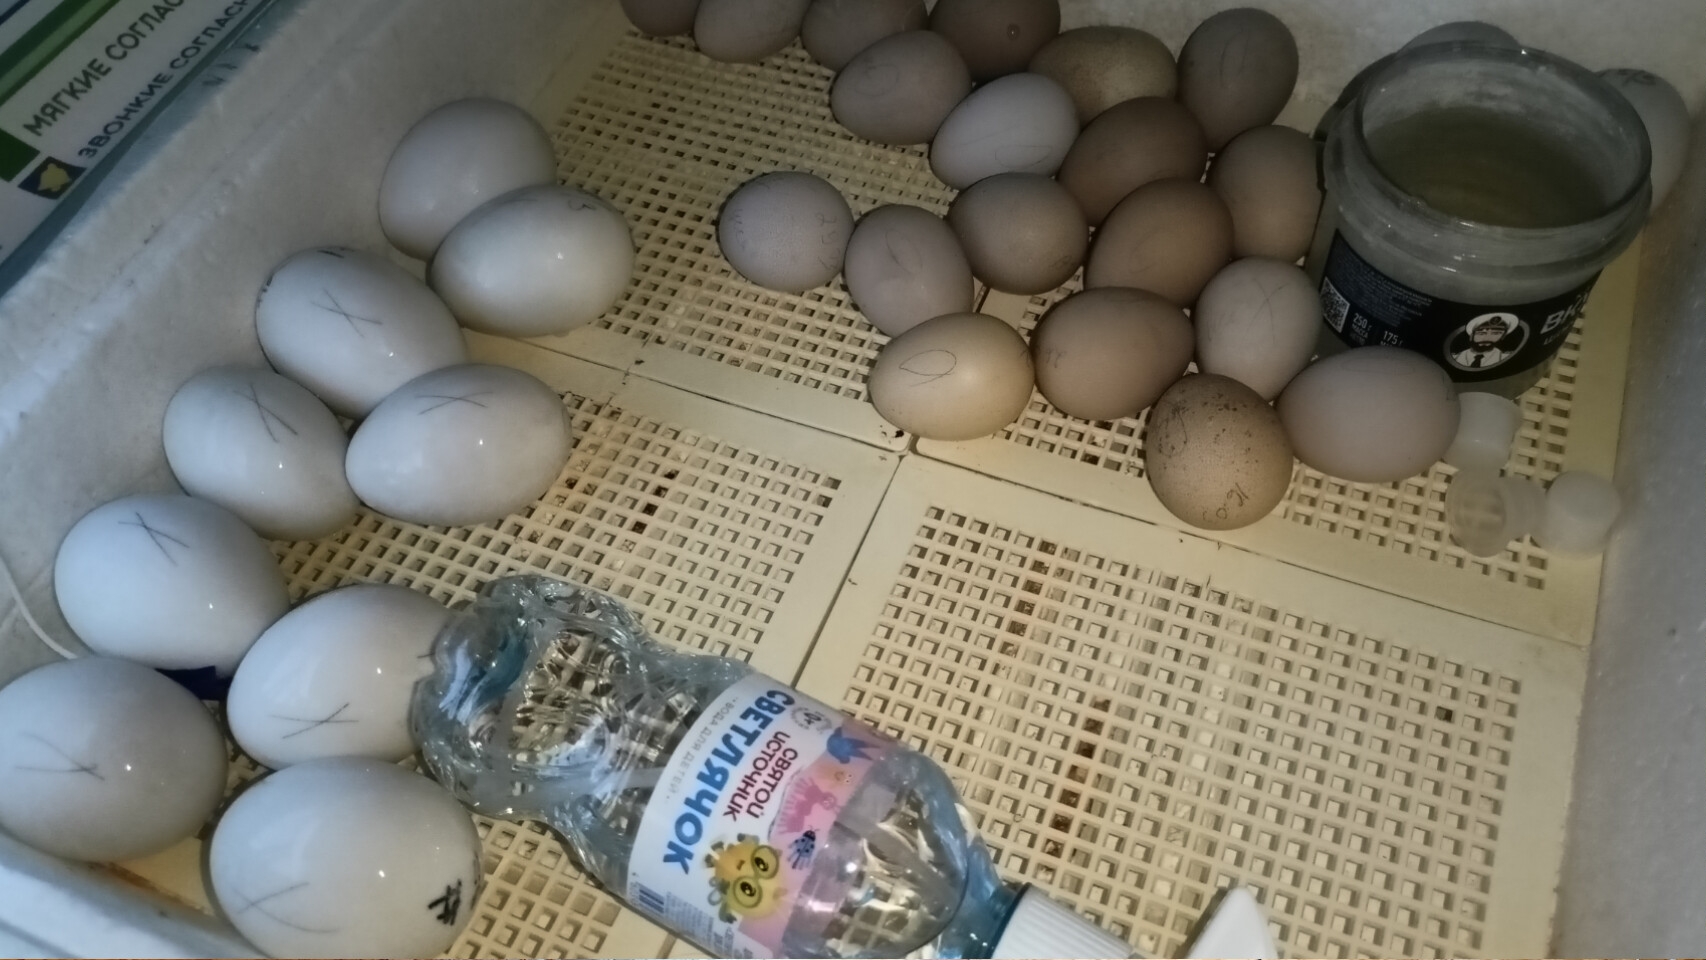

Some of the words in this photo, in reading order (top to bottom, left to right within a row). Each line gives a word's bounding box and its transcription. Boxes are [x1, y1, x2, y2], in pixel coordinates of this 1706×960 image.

[23, 58, 112, 137] МЯГКИЕ
[105, 0, 184, 61] СОГЛАС
[78, 72, 171, 158] ЗВОНКИЕ
[1383, 331, 1399, 345] 175
[663, 690, 795, 875] СВЕТЛЯЧОК
[723, 731, 791, 822] ИСТОЧНИК
[746, 748, 798, 819] СВЯТОЙ
